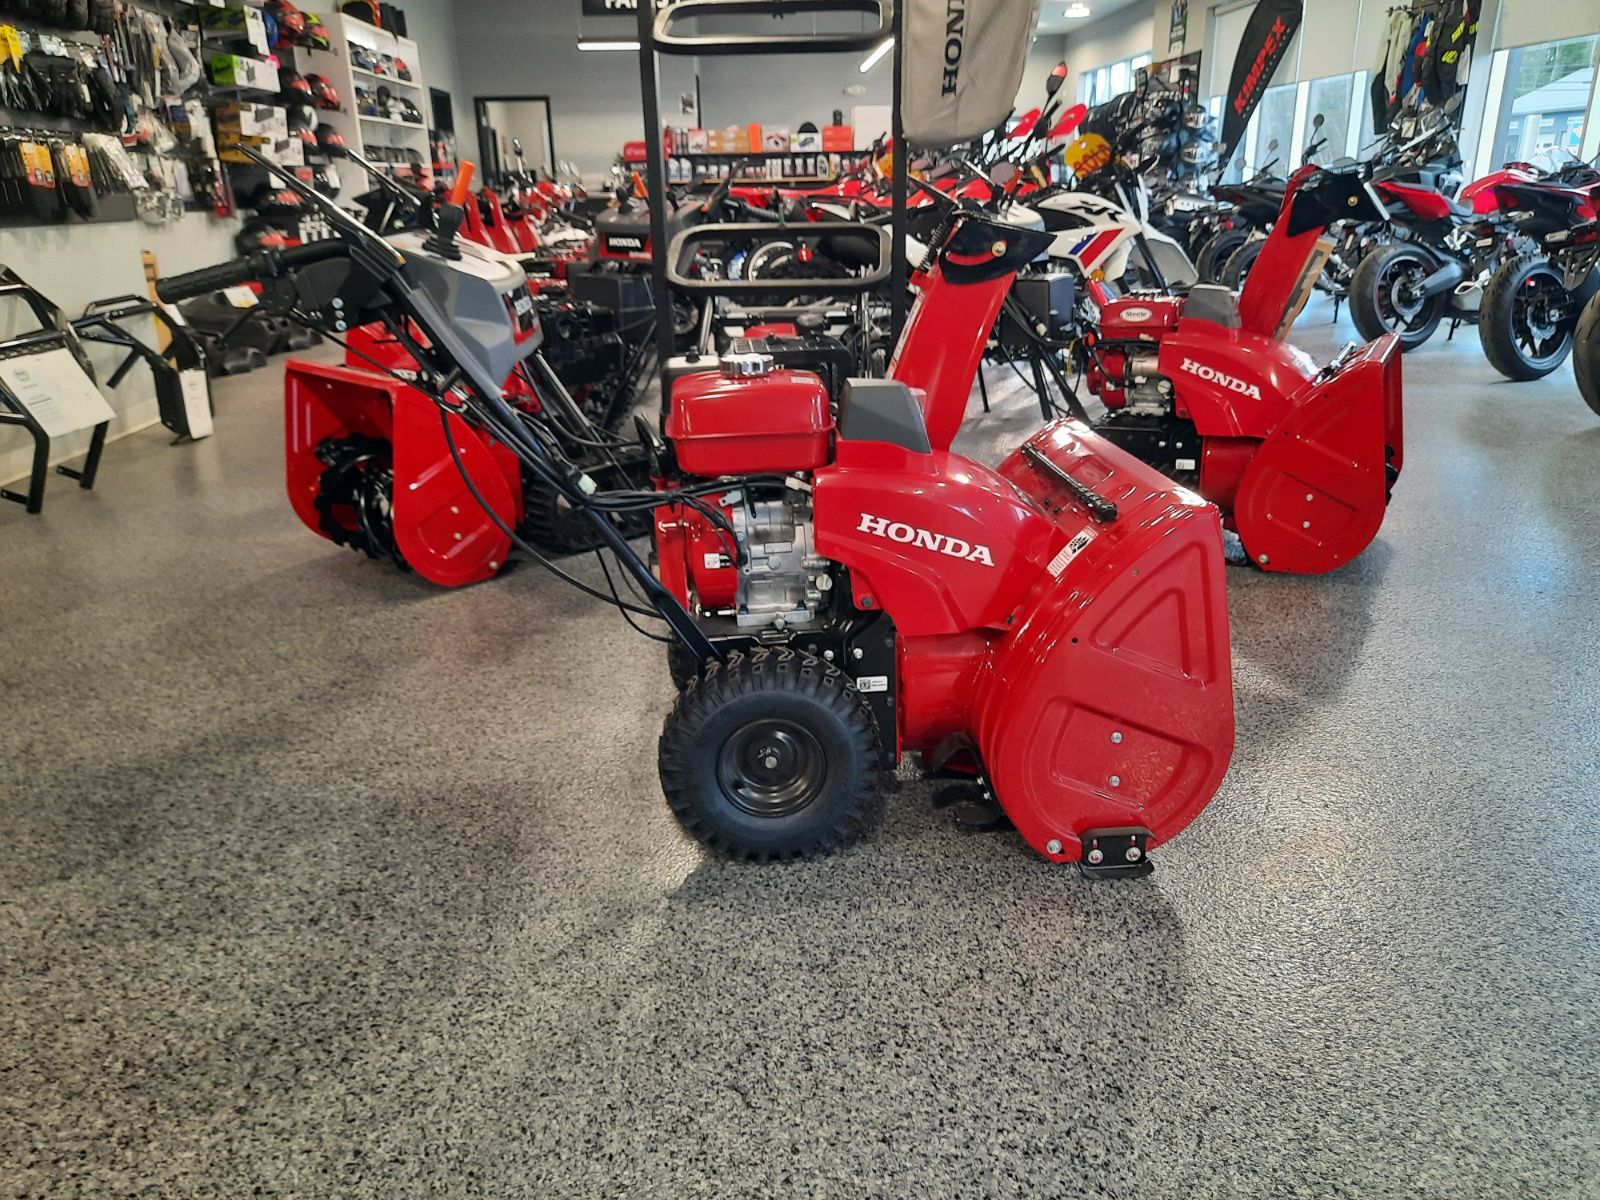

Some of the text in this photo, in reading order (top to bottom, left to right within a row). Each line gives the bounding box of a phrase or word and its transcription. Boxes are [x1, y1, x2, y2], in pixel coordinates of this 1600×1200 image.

[942, 0, 965, 97] HON
[1234, 16, 1286, 115] KIMPEX
[1180, 357, 1262, 401] HONDA
[856, 512, 995, 567] HONDA
